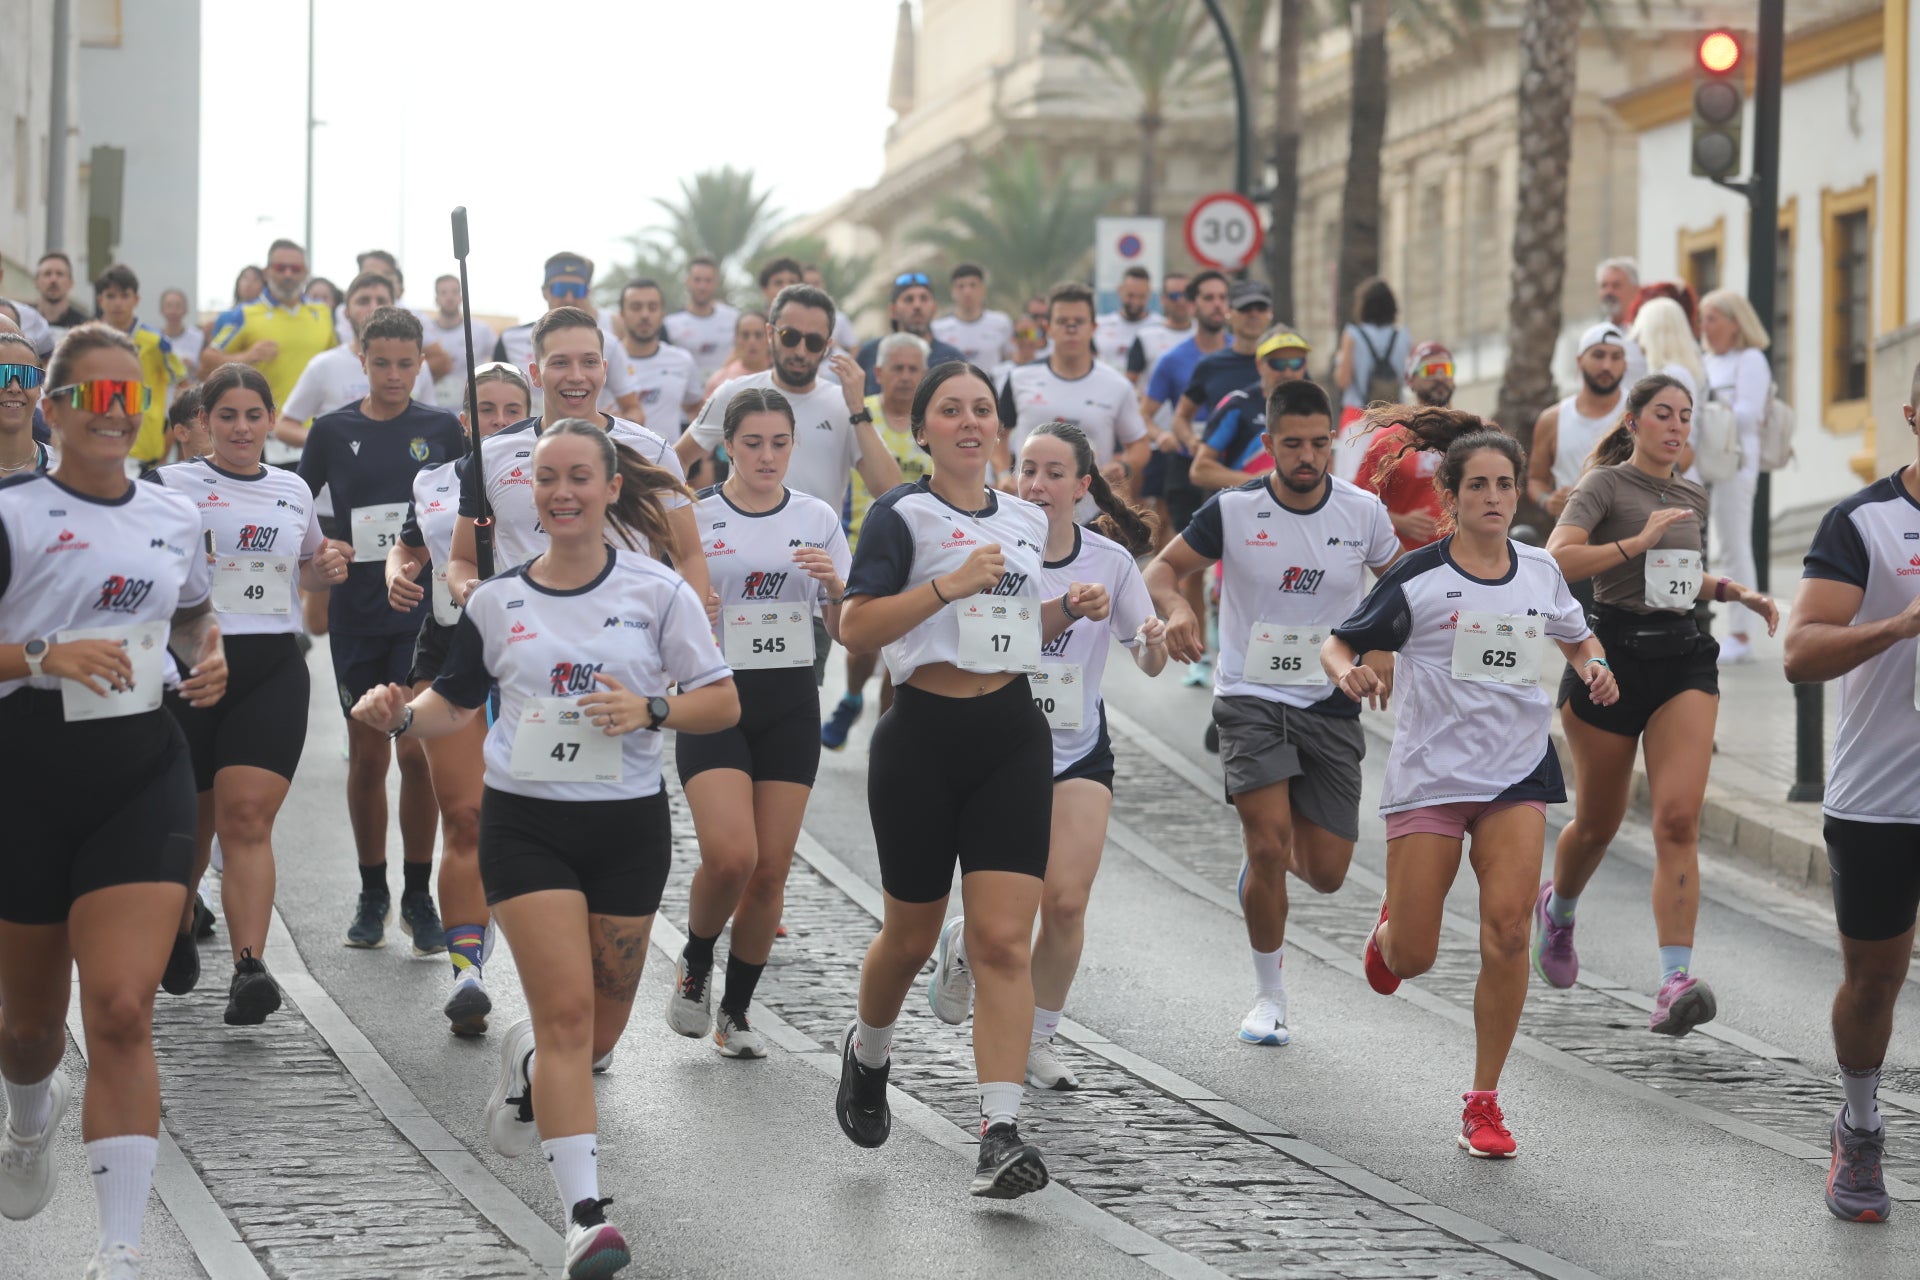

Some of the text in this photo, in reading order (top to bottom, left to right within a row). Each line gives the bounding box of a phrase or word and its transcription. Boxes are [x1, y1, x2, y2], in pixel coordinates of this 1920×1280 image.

[1203, 218, 1246, 245] 30
[500, 478, 532, 486] Santande
[197, 501, 231, 509] Santander
[378, 533, 400, 547] 31
[1246, 539, 1278, 548] Santander
[243, 585, 265, 600] 49
[752, 637, 786, 654] 545
[991, 634, 1011, 653] 17
[1270, 656, 1302, 671] 365
[1482, 649, 1517, 668] 625
[1033, 697, 1055, 714] 00
[550, 743, 581, 762] 47
